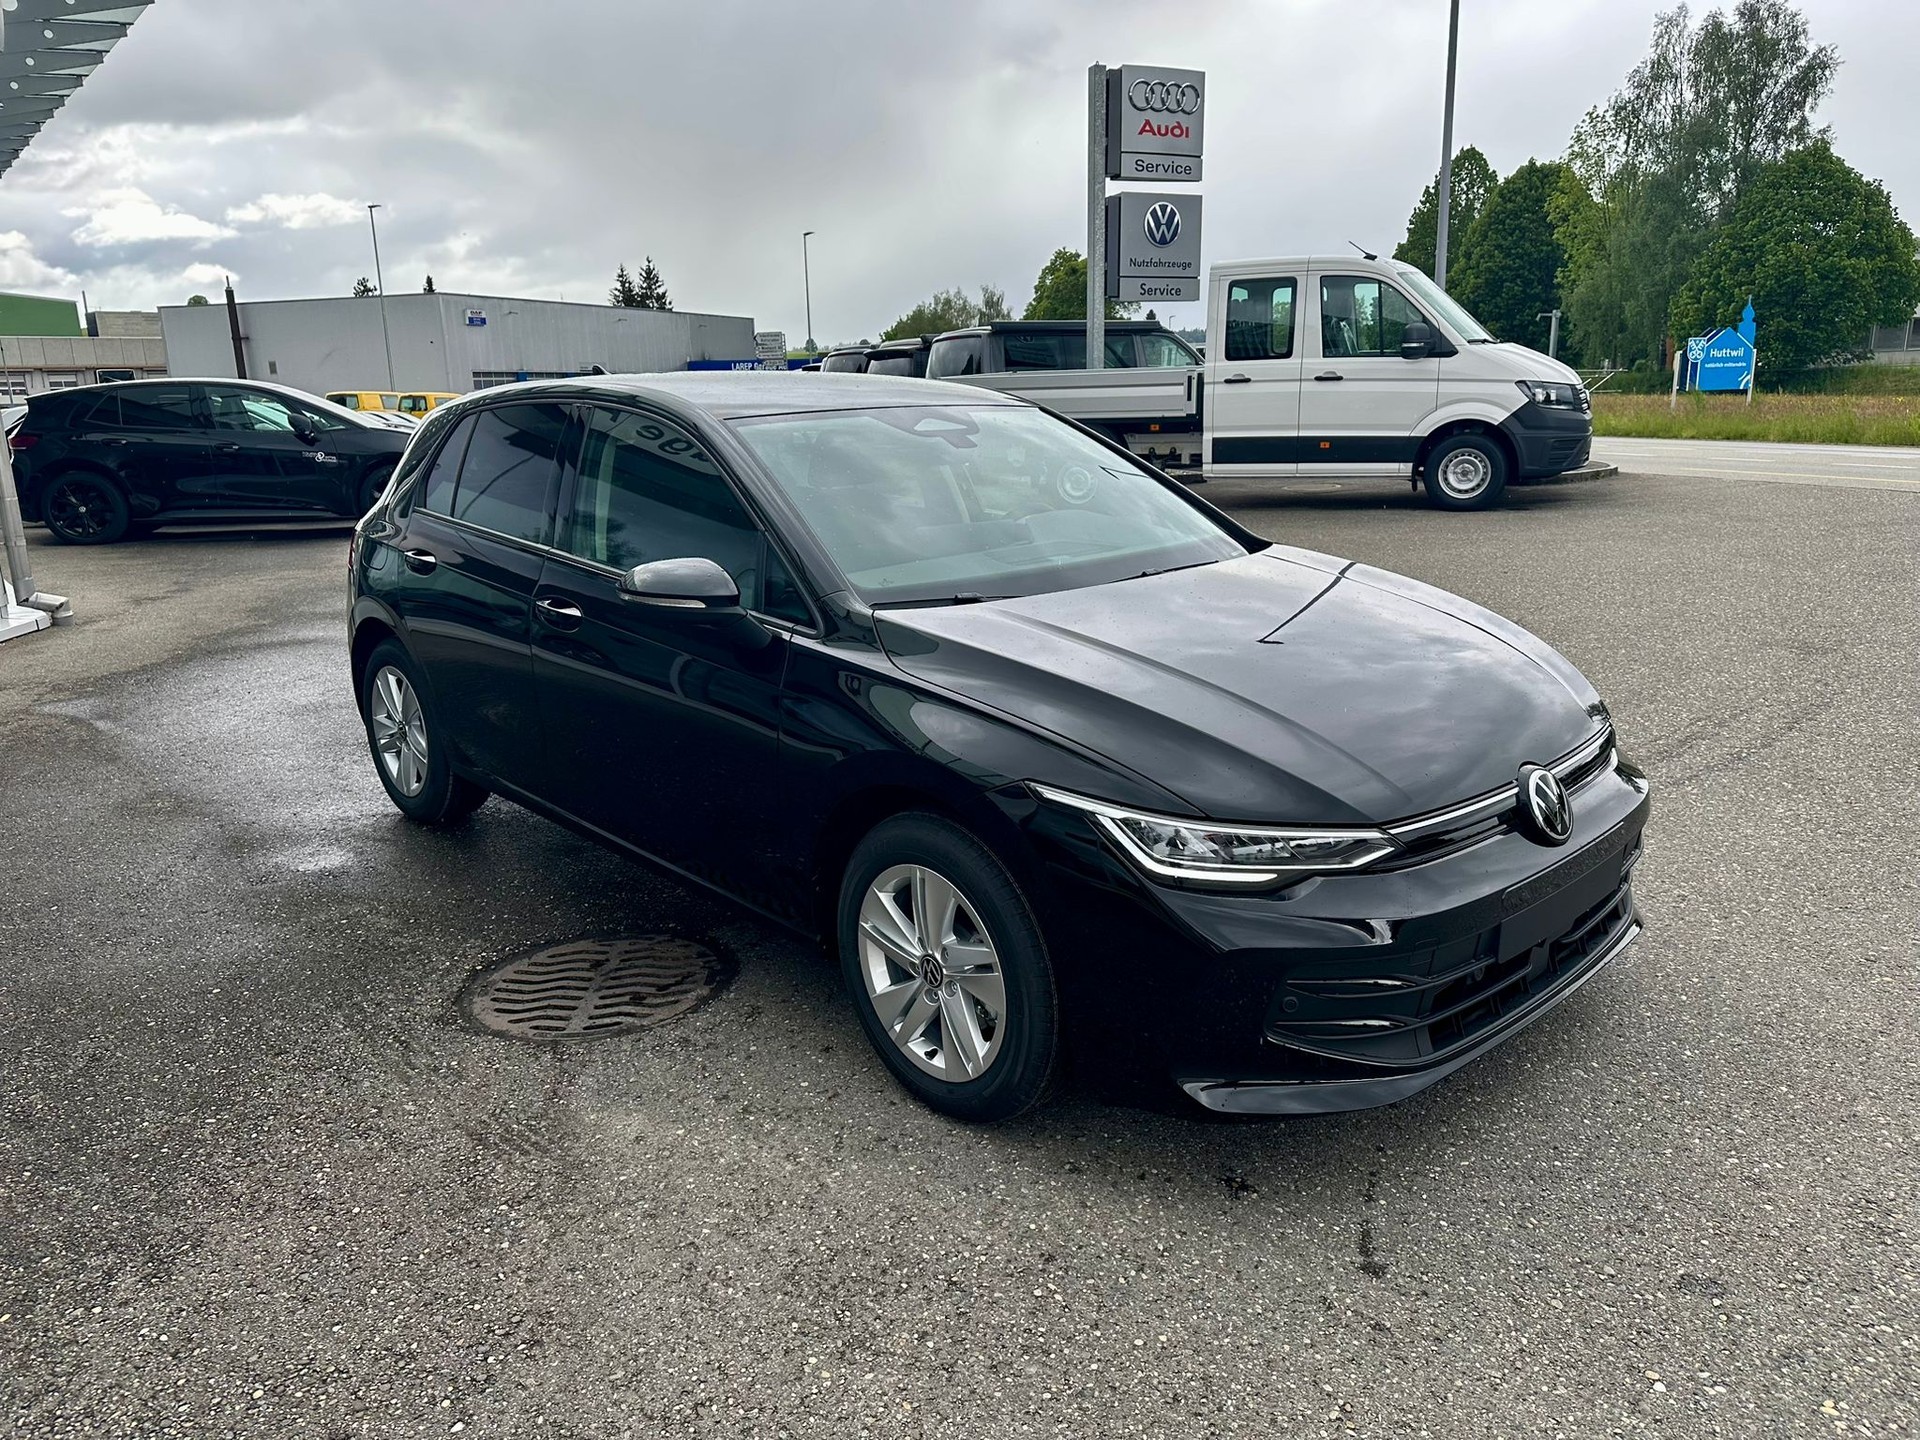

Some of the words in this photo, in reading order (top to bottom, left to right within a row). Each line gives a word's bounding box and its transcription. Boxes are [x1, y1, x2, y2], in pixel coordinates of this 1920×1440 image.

[1138, 119, 1190, 138] Audi
[1134, 159, 1192, 175] Service
[1129, 258, 1192, 270] Nutzfahrzeuge
[1139, 283, 1182, 297] Service
[1710, 347, 1744, 358] Huttwil
